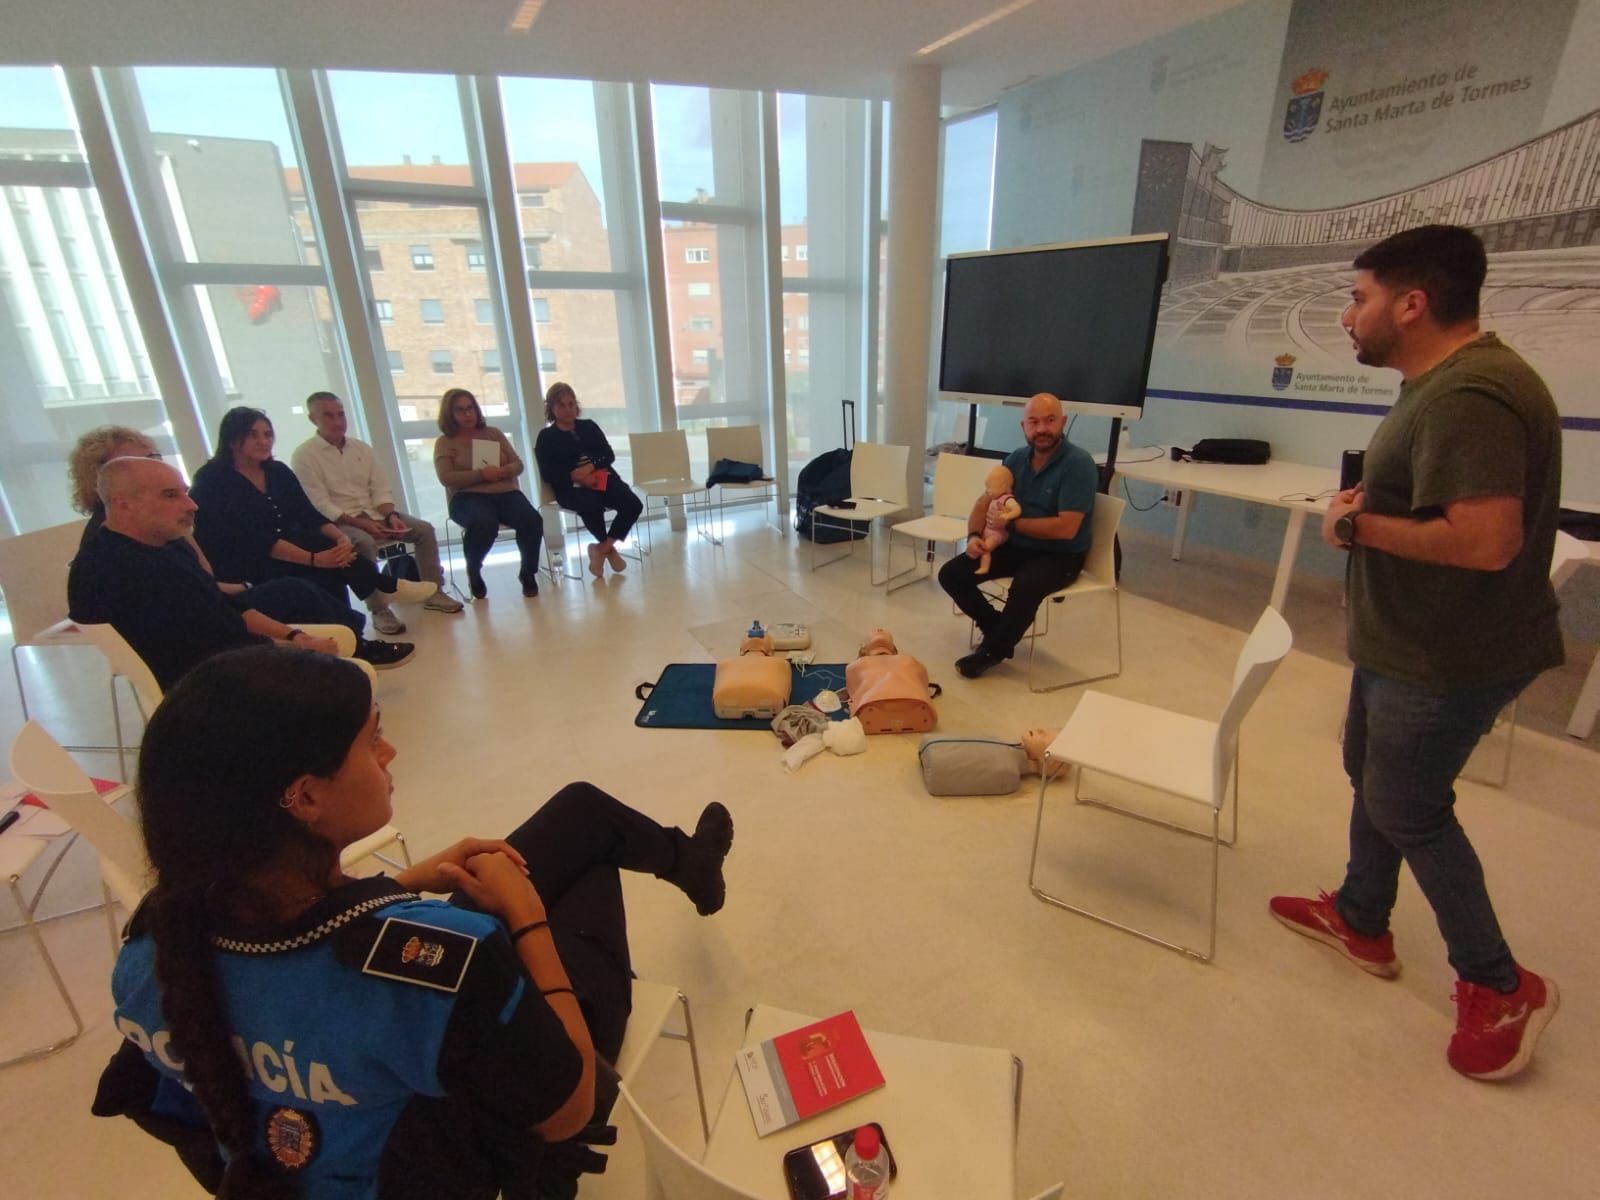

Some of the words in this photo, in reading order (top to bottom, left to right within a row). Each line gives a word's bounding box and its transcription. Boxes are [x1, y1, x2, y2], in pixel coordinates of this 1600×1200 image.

[1325, 113, 1369, 134] Santa
[1374, 100, 1426, 122] Marta
[1431, 89, 1455, 110] de
[1461, 75, 1532, 104] Tormes
[1328, 73, 1448, 114] Ayuntamiento
[1454, 61, 1479, 82] de
[1318, 383, 1345, 393] Marta
[117, 1015, 359, 1106] POICÍA
